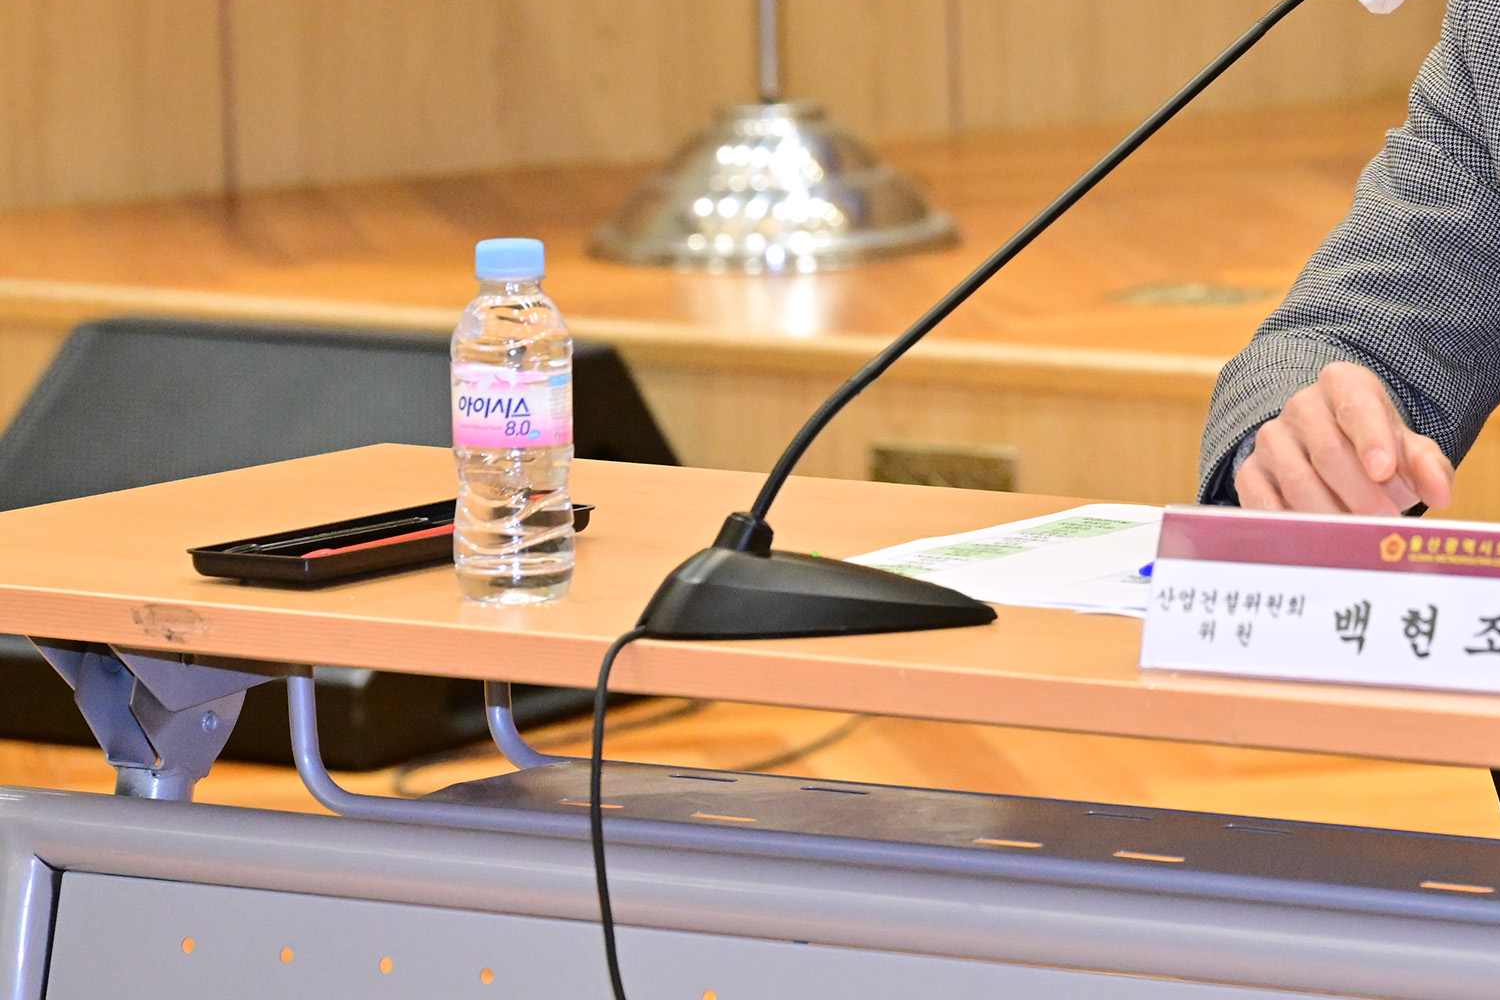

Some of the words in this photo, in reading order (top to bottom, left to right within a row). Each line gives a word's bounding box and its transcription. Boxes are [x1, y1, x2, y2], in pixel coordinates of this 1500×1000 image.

[458, 396, 531, 419] 아이시스
[505, 420, 531, 437] 8.0
[1157, 587, 1305, 618] 산업건설위원회
